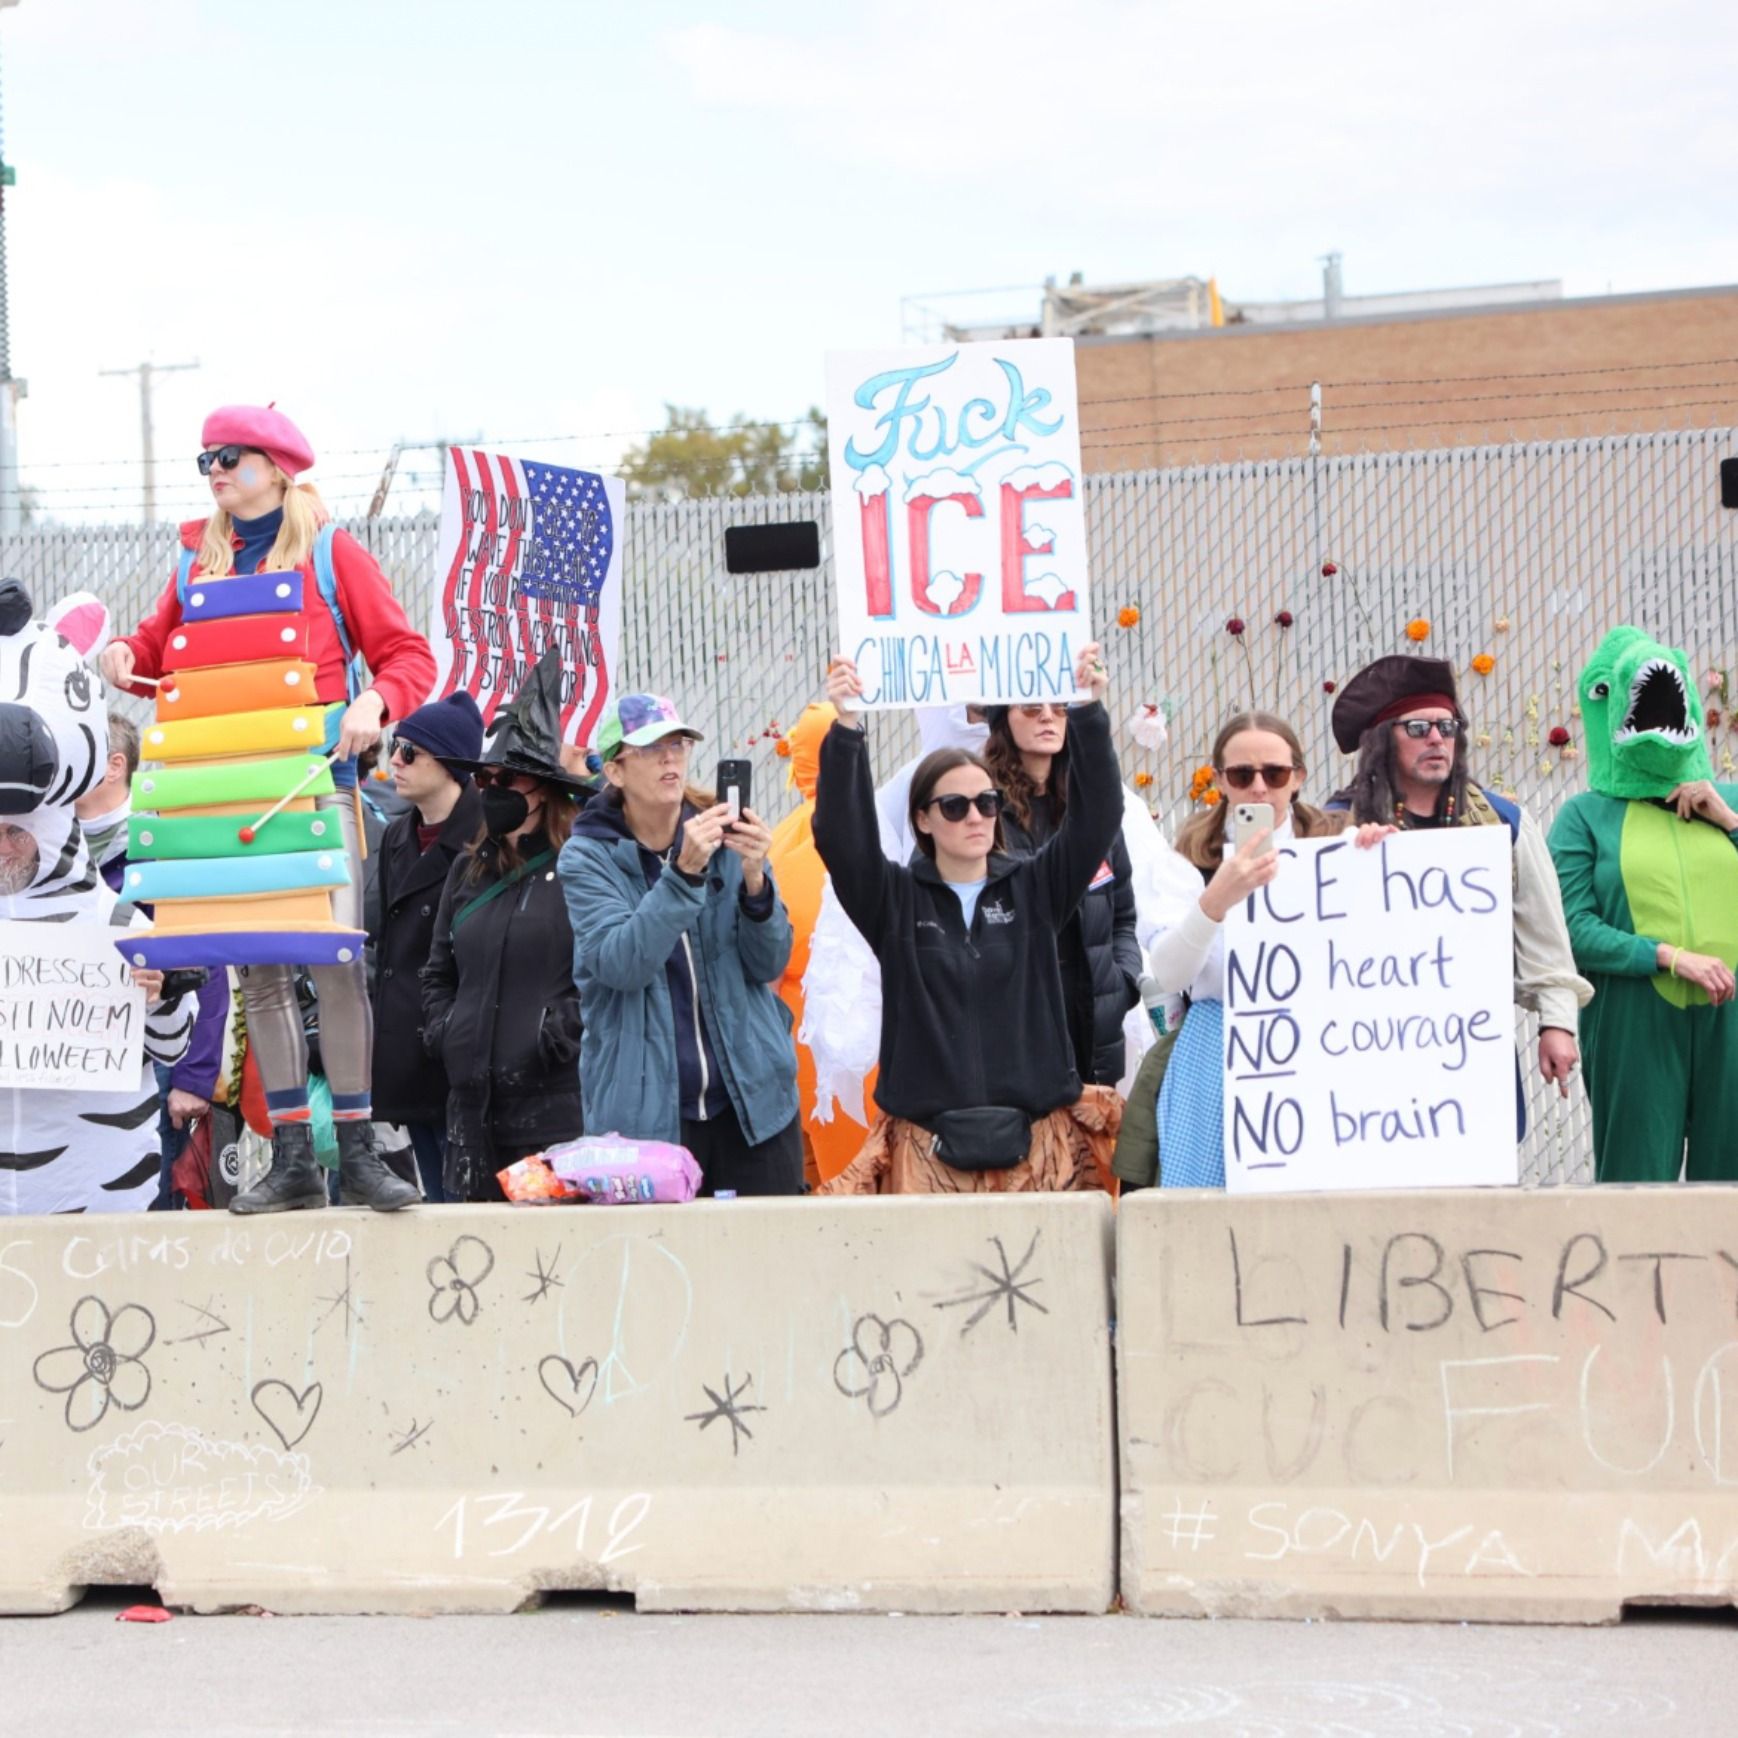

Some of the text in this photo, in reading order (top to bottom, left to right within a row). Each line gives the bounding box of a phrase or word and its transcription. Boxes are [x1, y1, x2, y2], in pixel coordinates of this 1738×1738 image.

[844, 351, 1064, 471] Fuck
[463, 487, 491, 525] YOU
[467, 530, 507, 567] WAVE
[515, 537, 545, 574] THIS
[853, 461, 1079, 621] ICE
[456, 567, 473, 600] IF
[584, 588, 600, 624] TO
[446, 604, 513, 649] DESTROY
[455, 648, 473, 686] IT
[855, 632, 1077, 705] CHINGA LA MIGRA
[1382, 840, 1498, 914] has
[2, 955, 111, 989] DRESSES
[1228, 936, 1453, 1008] NO heart
[47, 998, 132, 1040] NOEM
[1228, 1014, 1300, 1071] NO
[1320, 1009, 1502, 1071] courage
[1233, 1089, 1466, 1162] NO brain
[124, 1441, 208, 1490] OUR
[122, 1472, 284, 1518] STREETS
[434, 1492, 653, 1565] 1312
